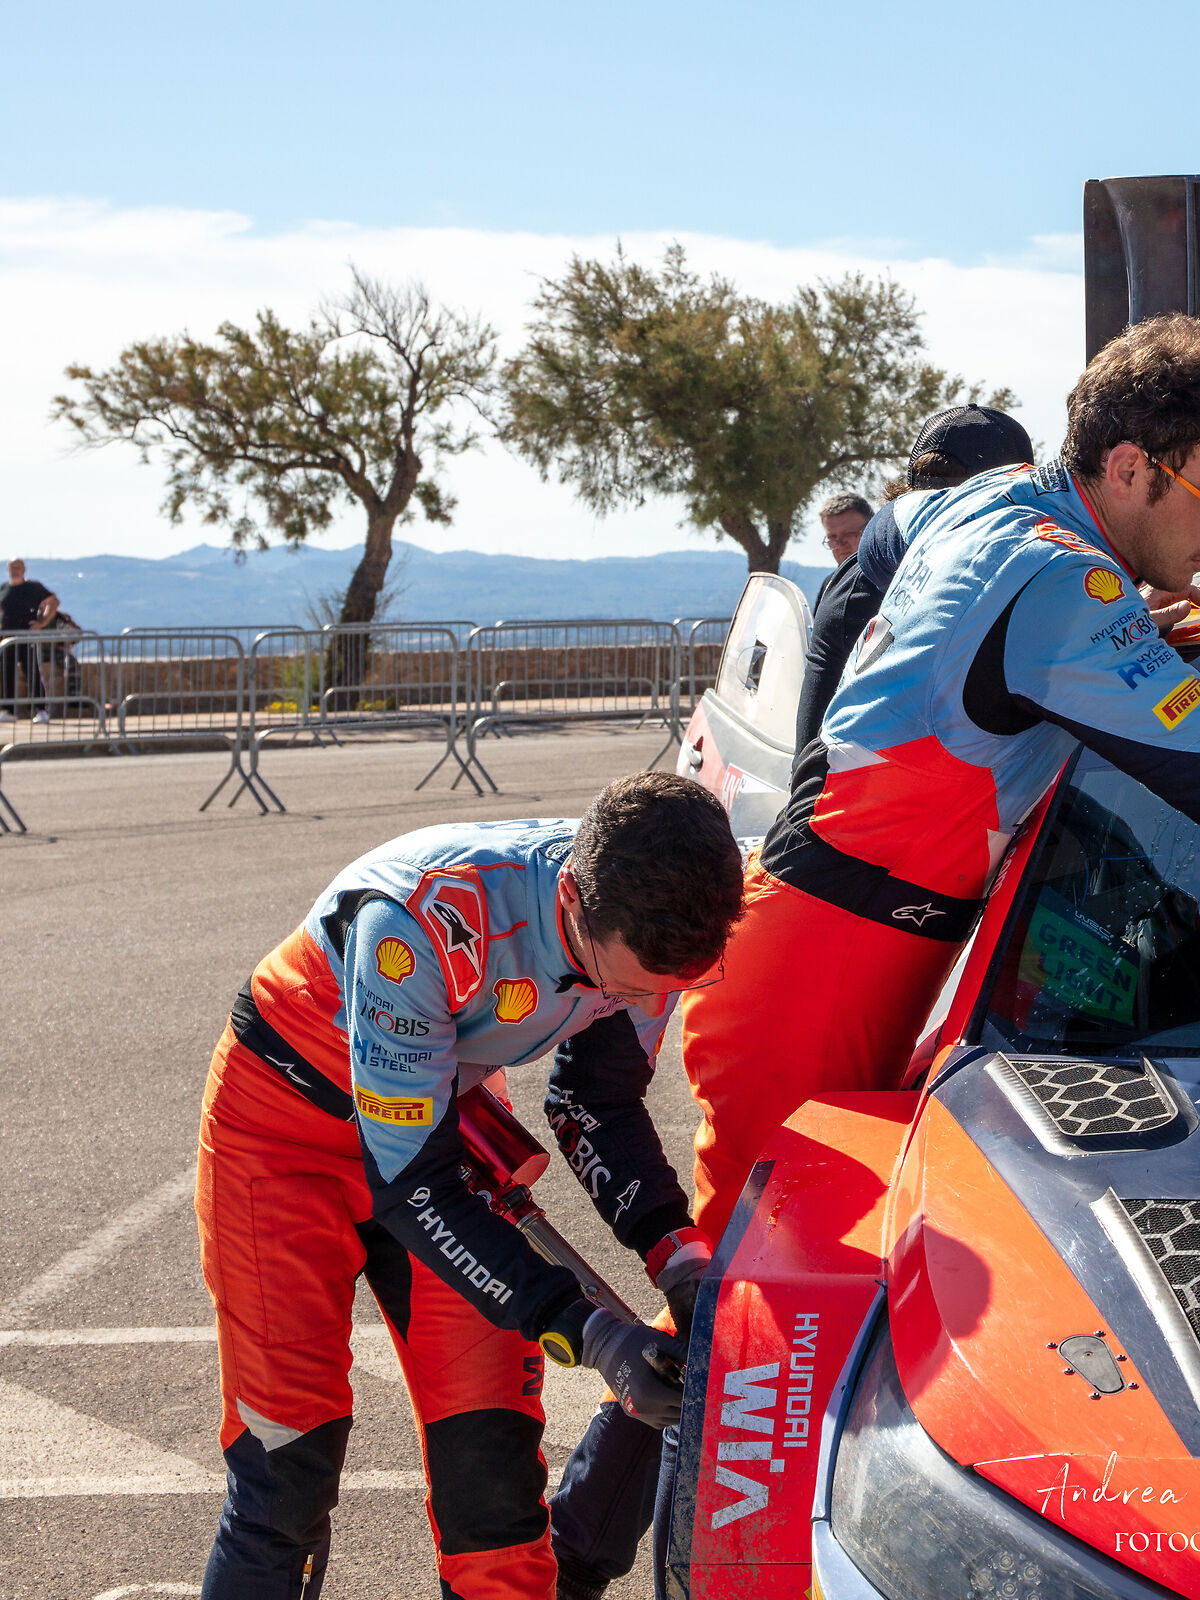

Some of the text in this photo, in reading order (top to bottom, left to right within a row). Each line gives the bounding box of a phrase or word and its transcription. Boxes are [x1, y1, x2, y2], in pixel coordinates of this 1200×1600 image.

[1090, 611, 1137, 644] HYUNDAI
[1146, 650, 1174, 673] STEEL
[1039, 923, 1131, 990] GREEN
[1041, 951, 1123, 1012] LIGHT
[360, 1000, 430, 1037] MOBIS
[369, 1056, 417, 1074] STEEL
[356, 1090, 425, 1121] PIRELLI
[416, 1206, 514, 1305] HYUNDAI
[782, 1313, 820, 1448] HYUNDAI
[711, 1361, 785, 1531] WIA
